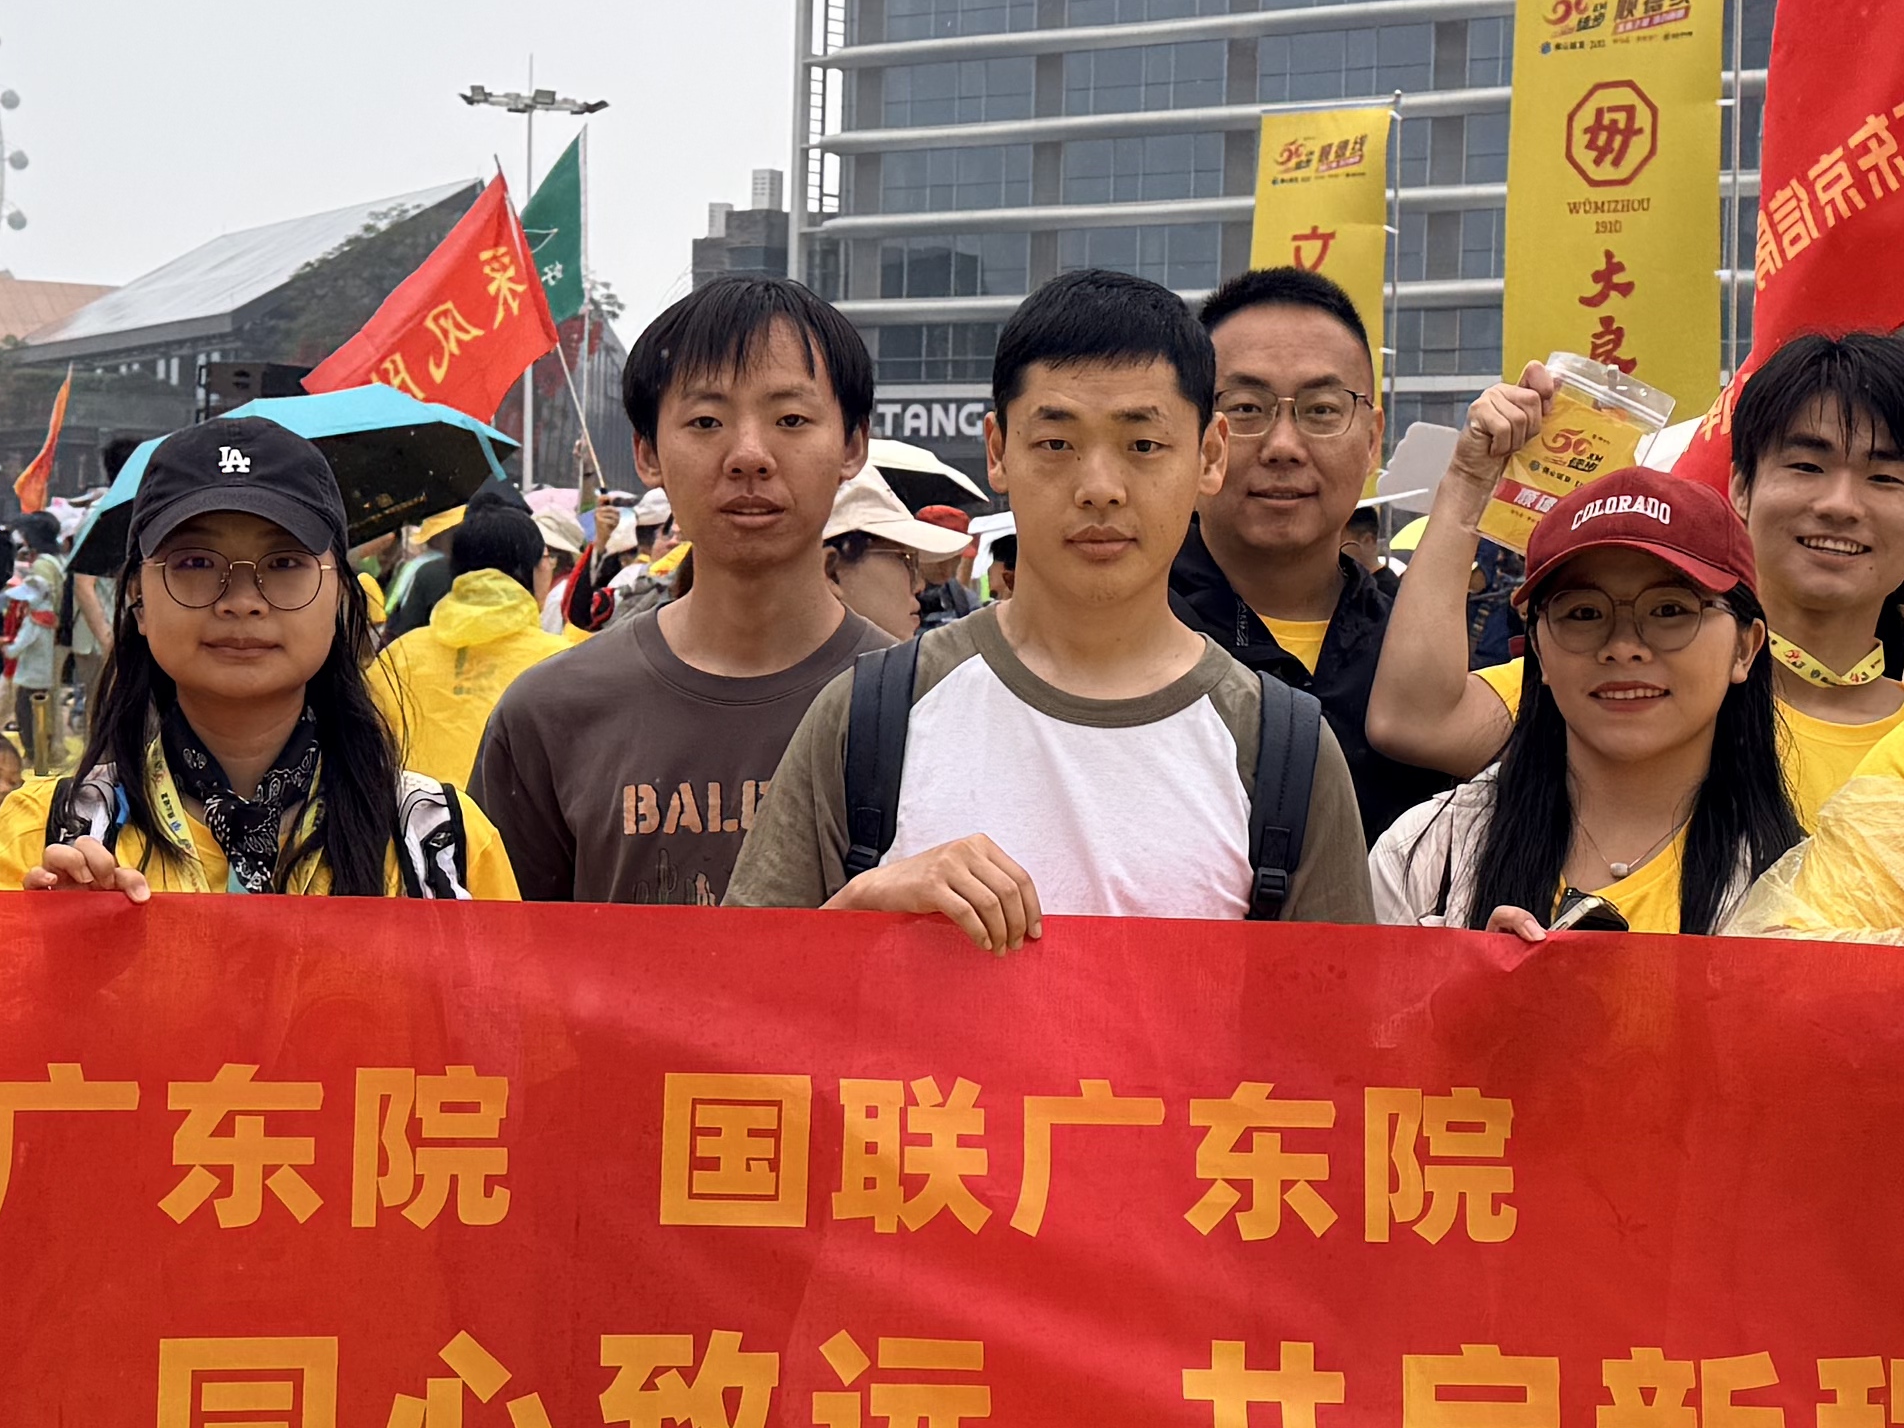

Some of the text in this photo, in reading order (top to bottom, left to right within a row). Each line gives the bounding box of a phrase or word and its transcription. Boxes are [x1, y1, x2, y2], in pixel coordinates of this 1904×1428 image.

[1594, 219, 1623, 235] 1910
[218, 446, 251, 474] LA
[1570, 494, 1672, 532] COLORADO
[659, 1072, 1517, 1243] 国联广东院
